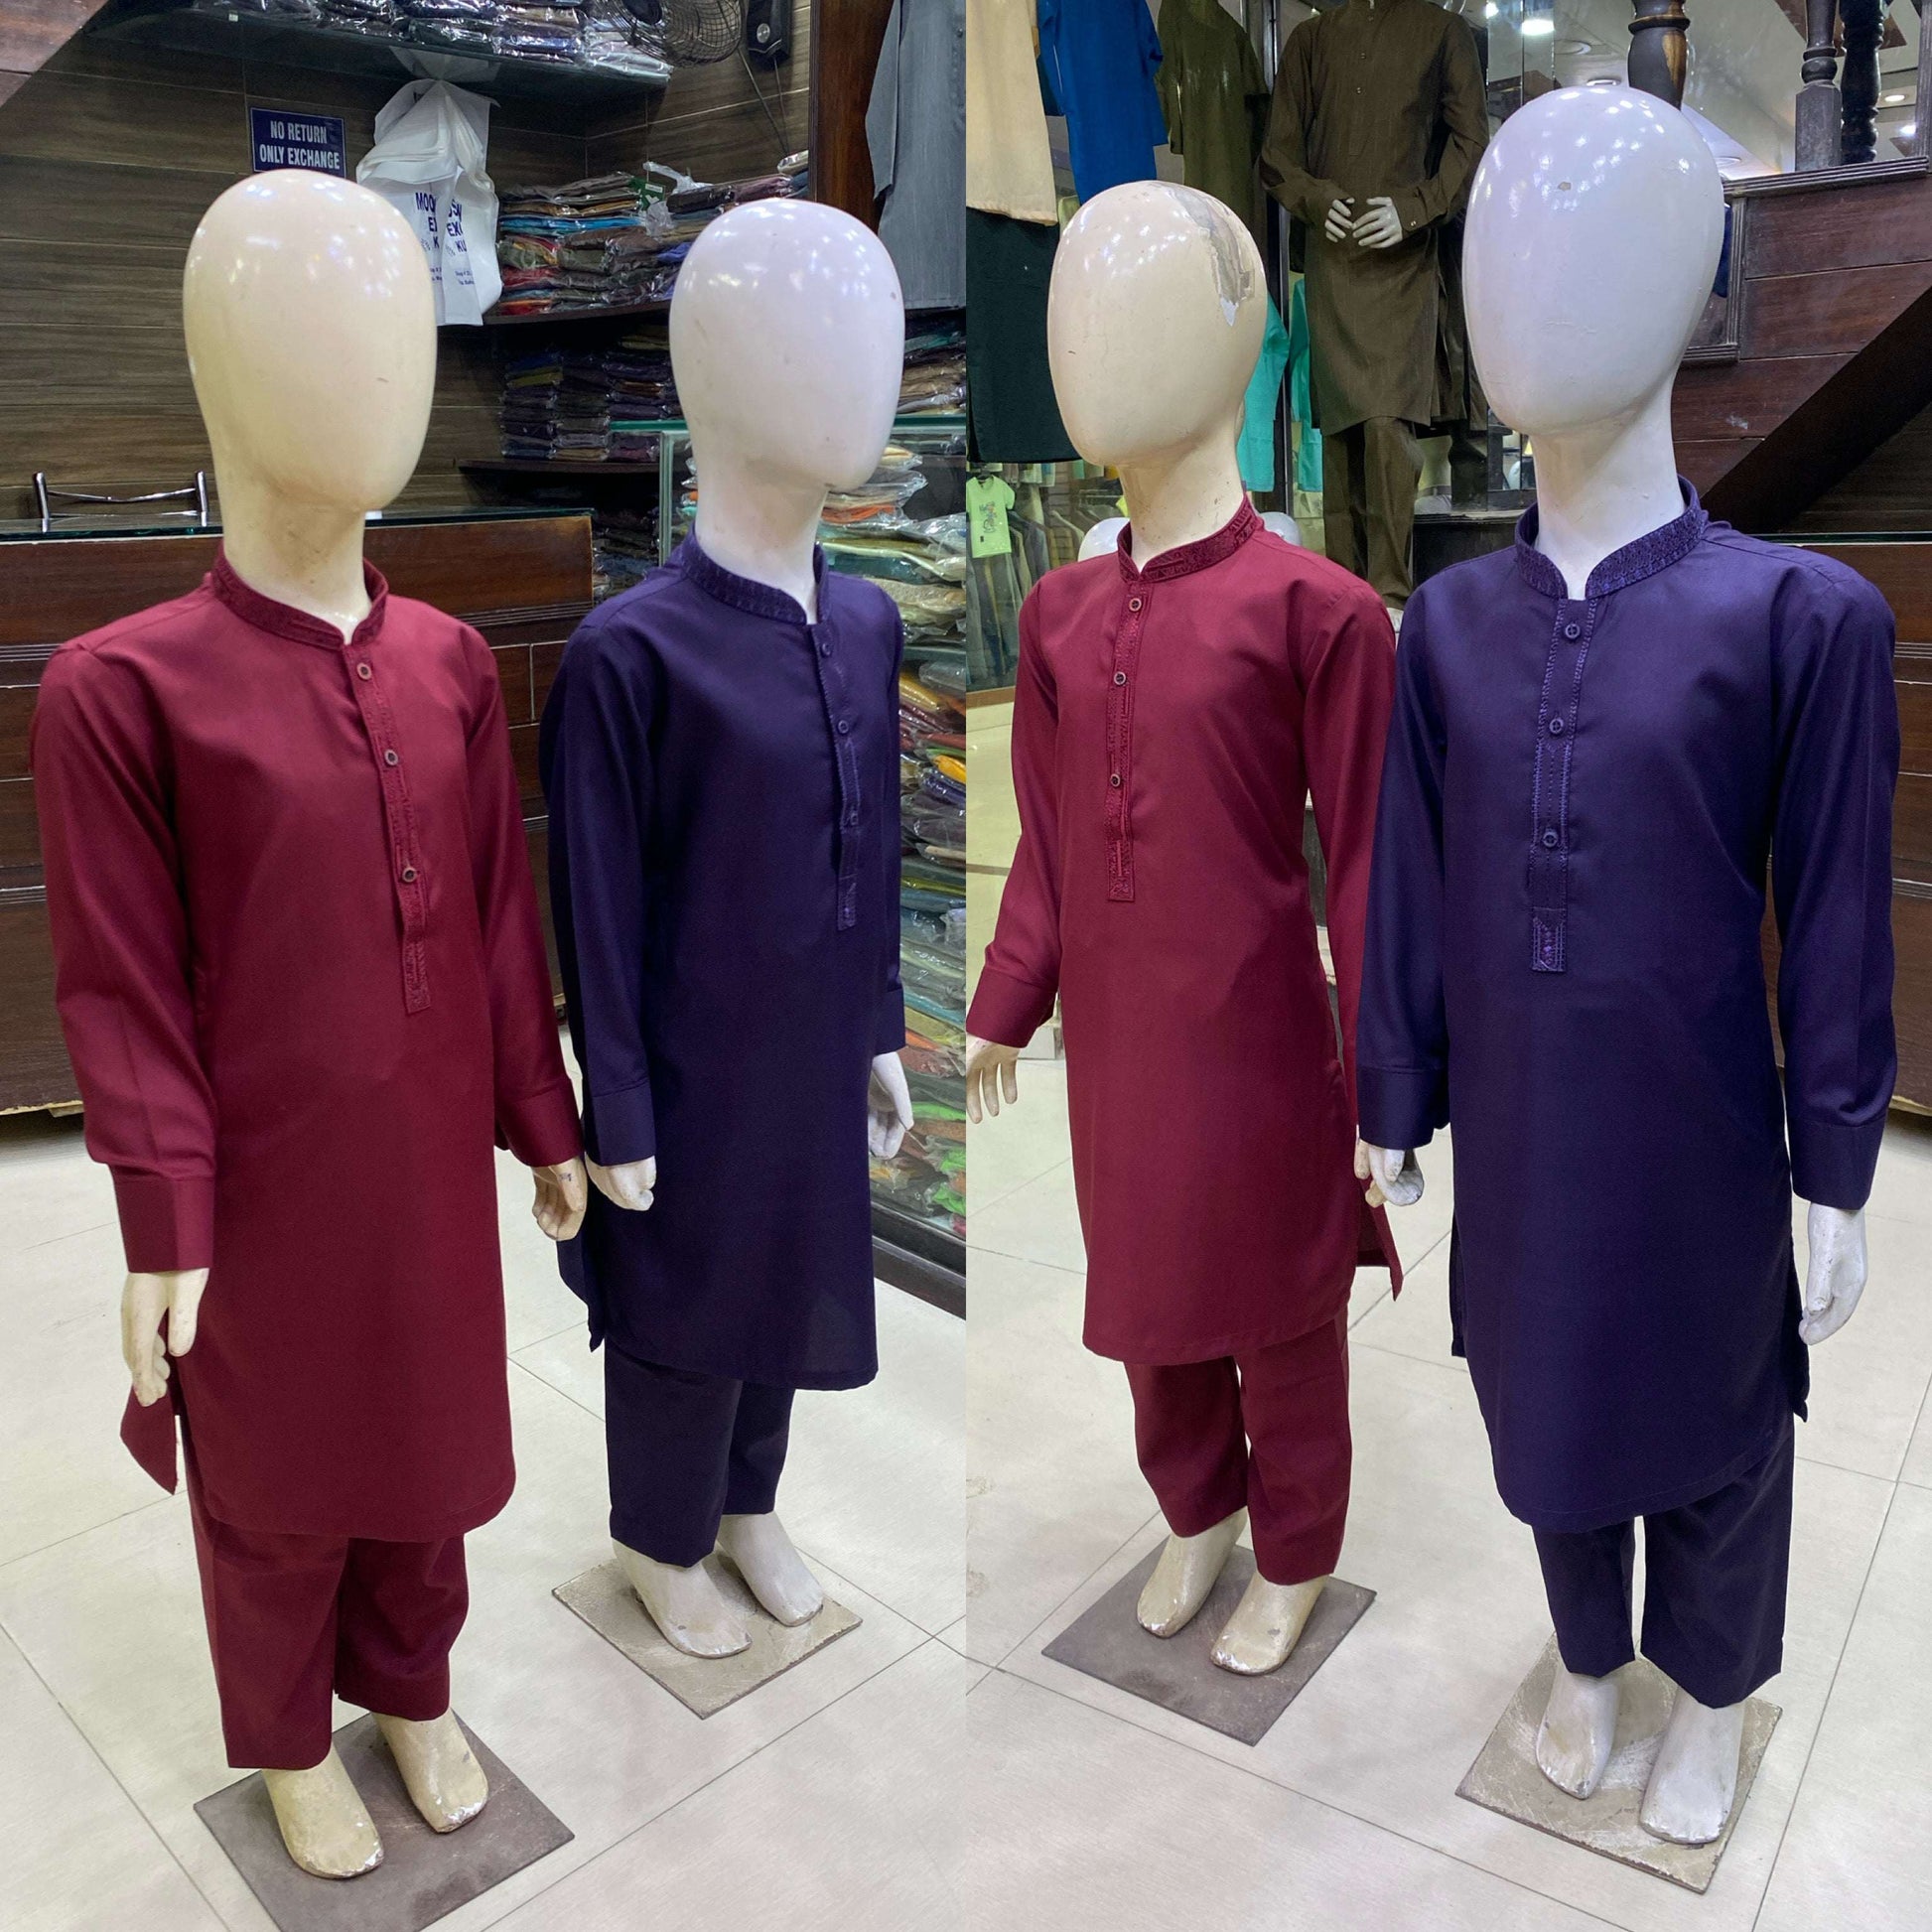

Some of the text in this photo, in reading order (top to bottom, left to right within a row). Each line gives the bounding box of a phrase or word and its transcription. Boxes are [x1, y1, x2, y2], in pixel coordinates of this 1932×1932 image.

[270, 120, 328, 144] NO RETURN
[259, 144, 341, 170] ONLY EXCHANGE
[415, 192, 437, 212] MOO
